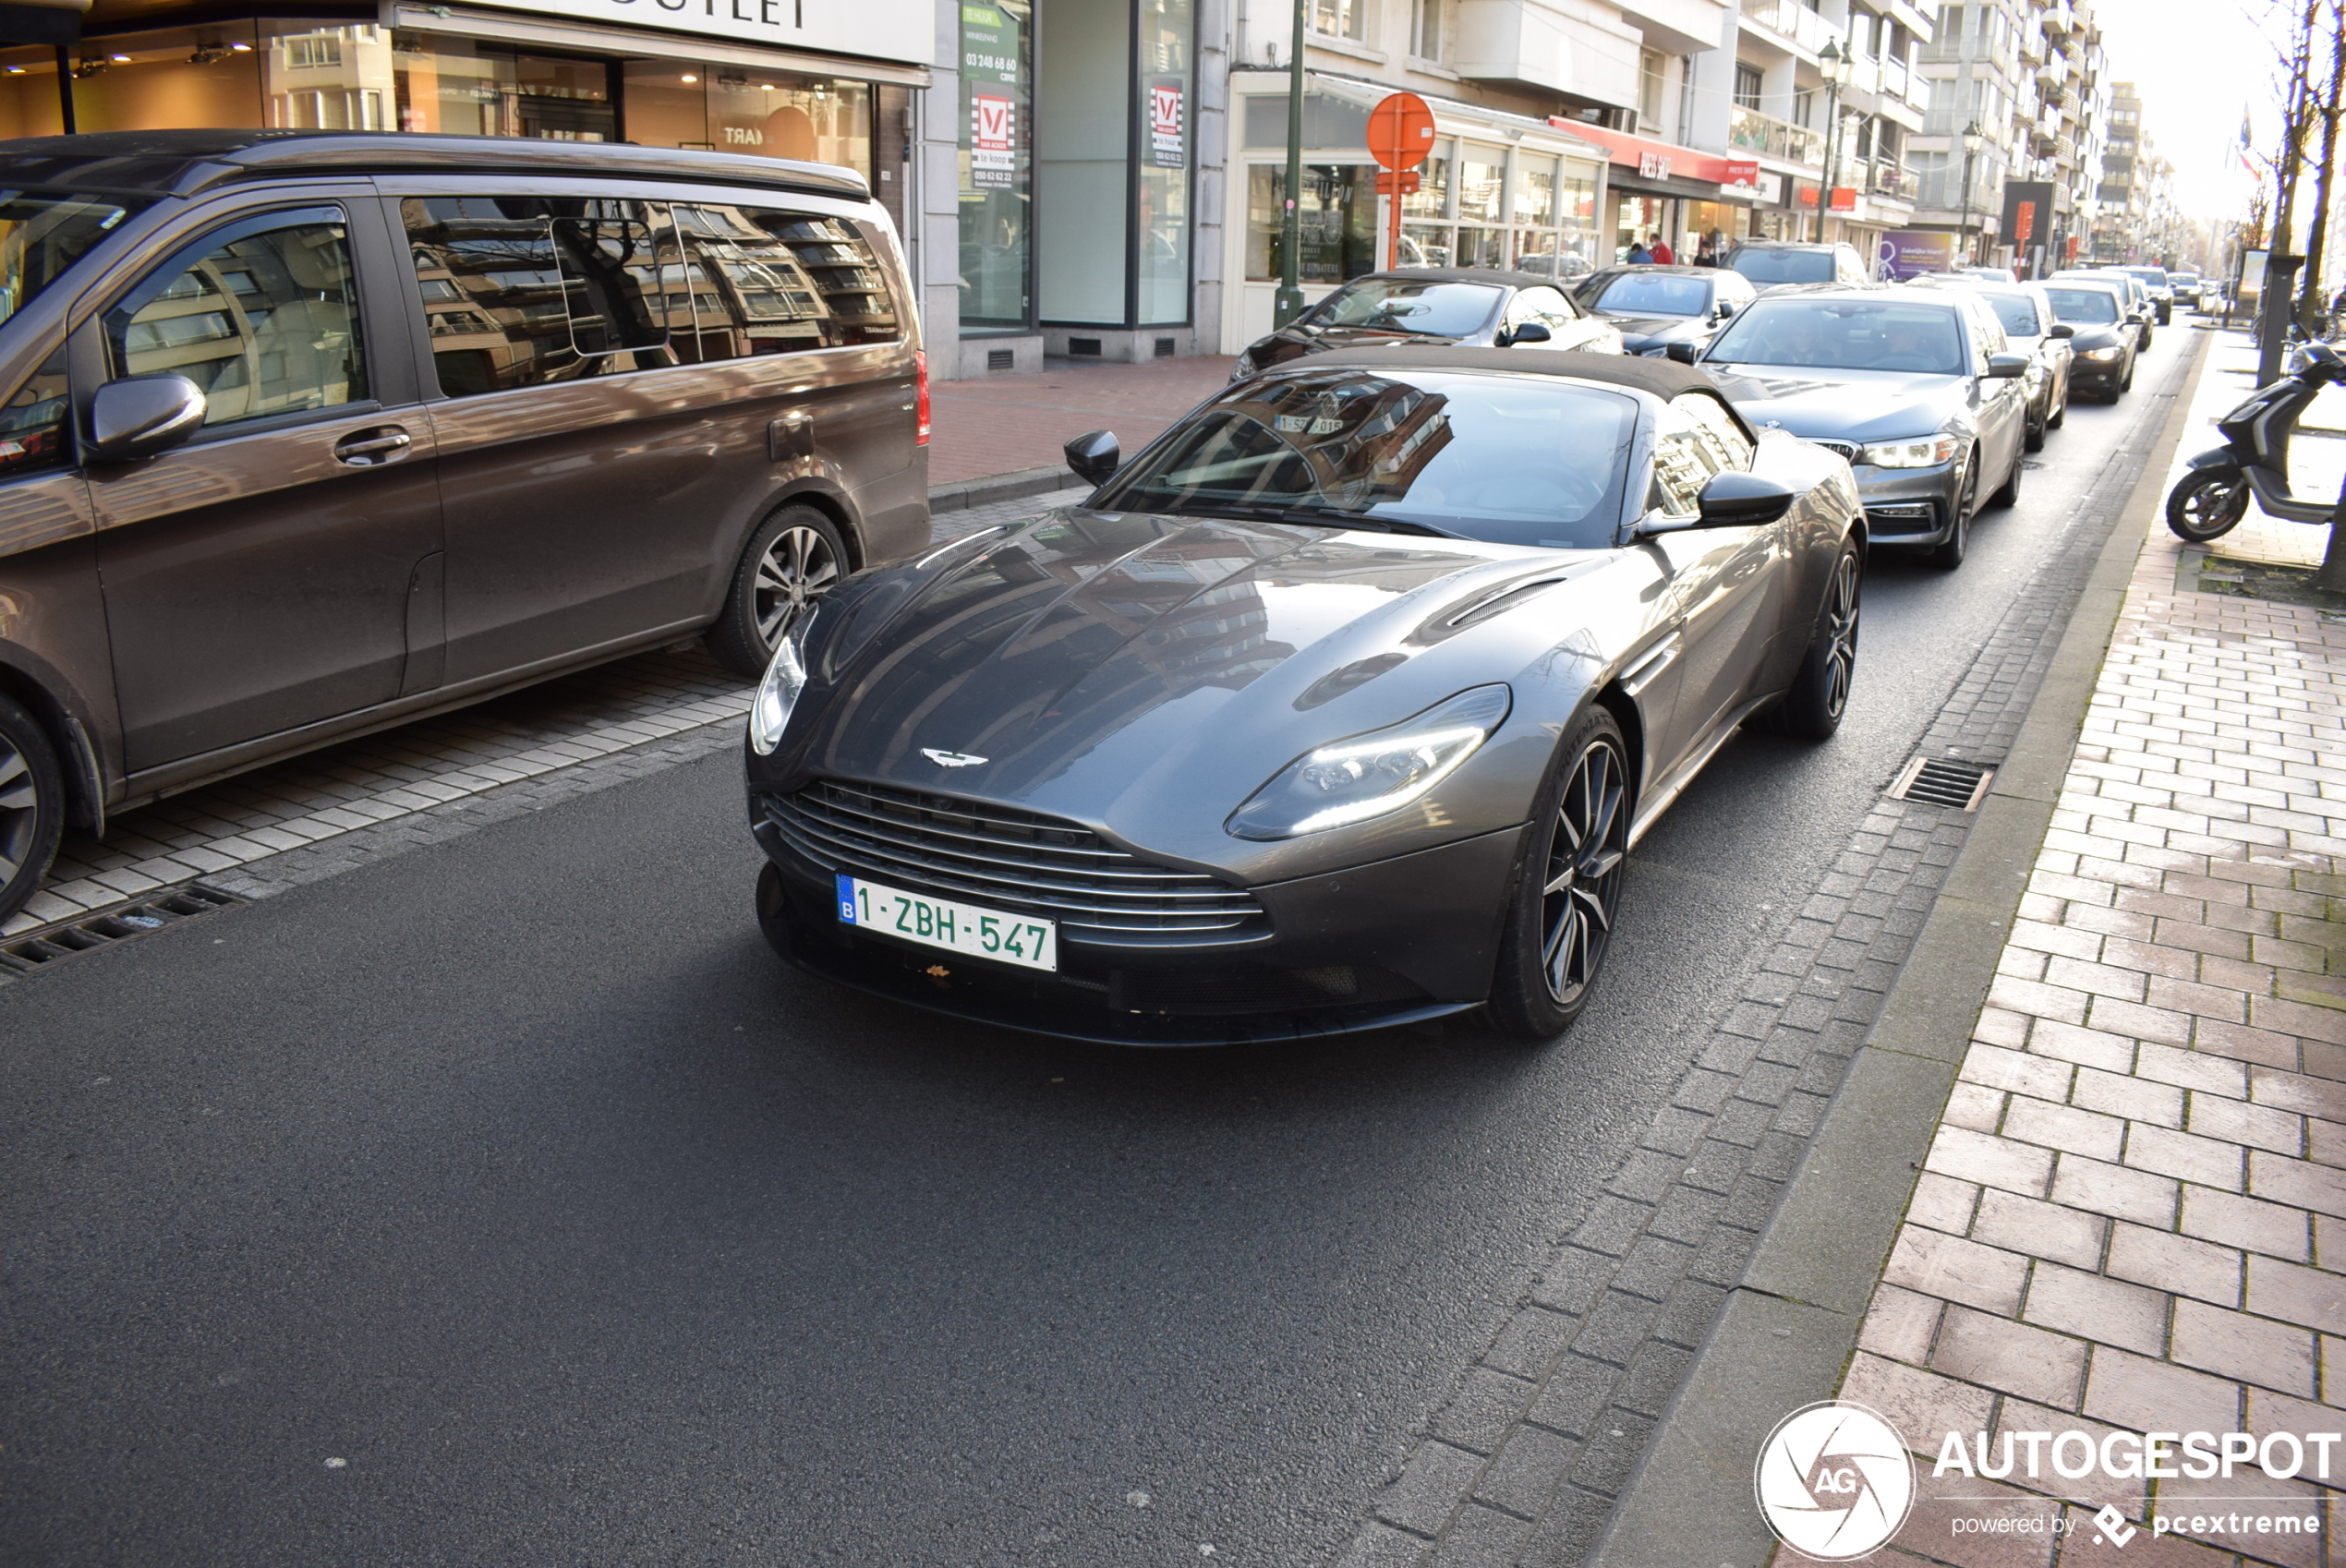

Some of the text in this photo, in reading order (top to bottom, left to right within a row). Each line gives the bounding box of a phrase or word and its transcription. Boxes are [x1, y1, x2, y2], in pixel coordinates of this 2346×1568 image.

[610, 0, 803, 29] LET
[966, 8, 993, 23] TE HUUR
[966, 53, 1017, 71] 03 248 68 60
[1000, 72, 1017, 82] CBRE
[980, 153, 1006, 165] te koop
[974, 170, 1012, 181] 050 62 62 22
[1728, 166, 1757, 175] PRESS SHOP
[1557, 715, 1602, 782] POTENZA
[842, 901, 854, 920] B
[859, 887, 1046, 961] 1-ZBH-547
